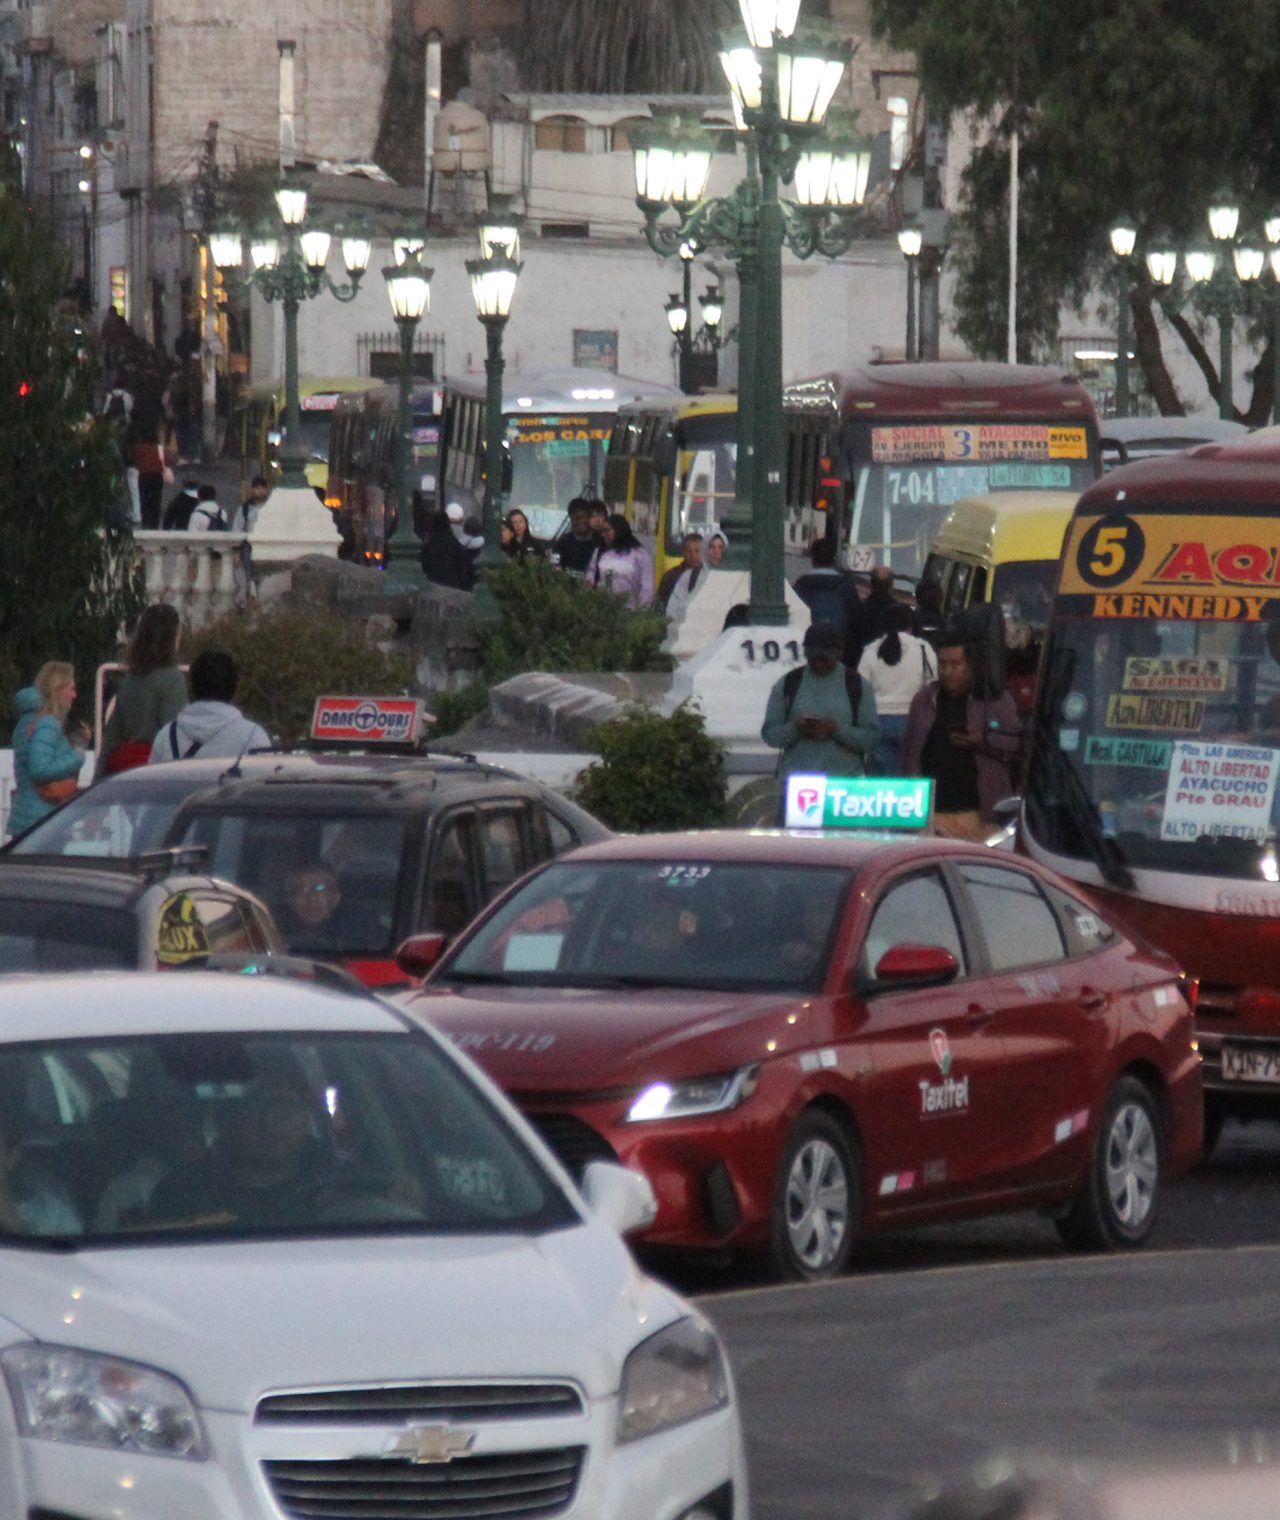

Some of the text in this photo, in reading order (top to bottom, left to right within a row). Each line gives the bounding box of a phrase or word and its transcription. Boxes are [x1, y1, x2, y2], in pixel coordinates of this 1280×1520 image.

[952, 430, 973, 458] 3
[978, 440, 1048, 450] METRO
[888, 470, 934, 504] 7-04
[1089, 527, 1128, 577] 5
[1093, 594, 1270, 621] KENNEDY
[1180, 759, 1270, 779] ALTO LIBERTAD
[1180, 778, 1268, 793] AYACUCHO
[828, 790, 923, 818] Taxitel
[1212, 795, 1265, 807] GRAU
[1164, 822, 1197, 837] ALTO
[919, 1076, 968, 1113] Taxitel
